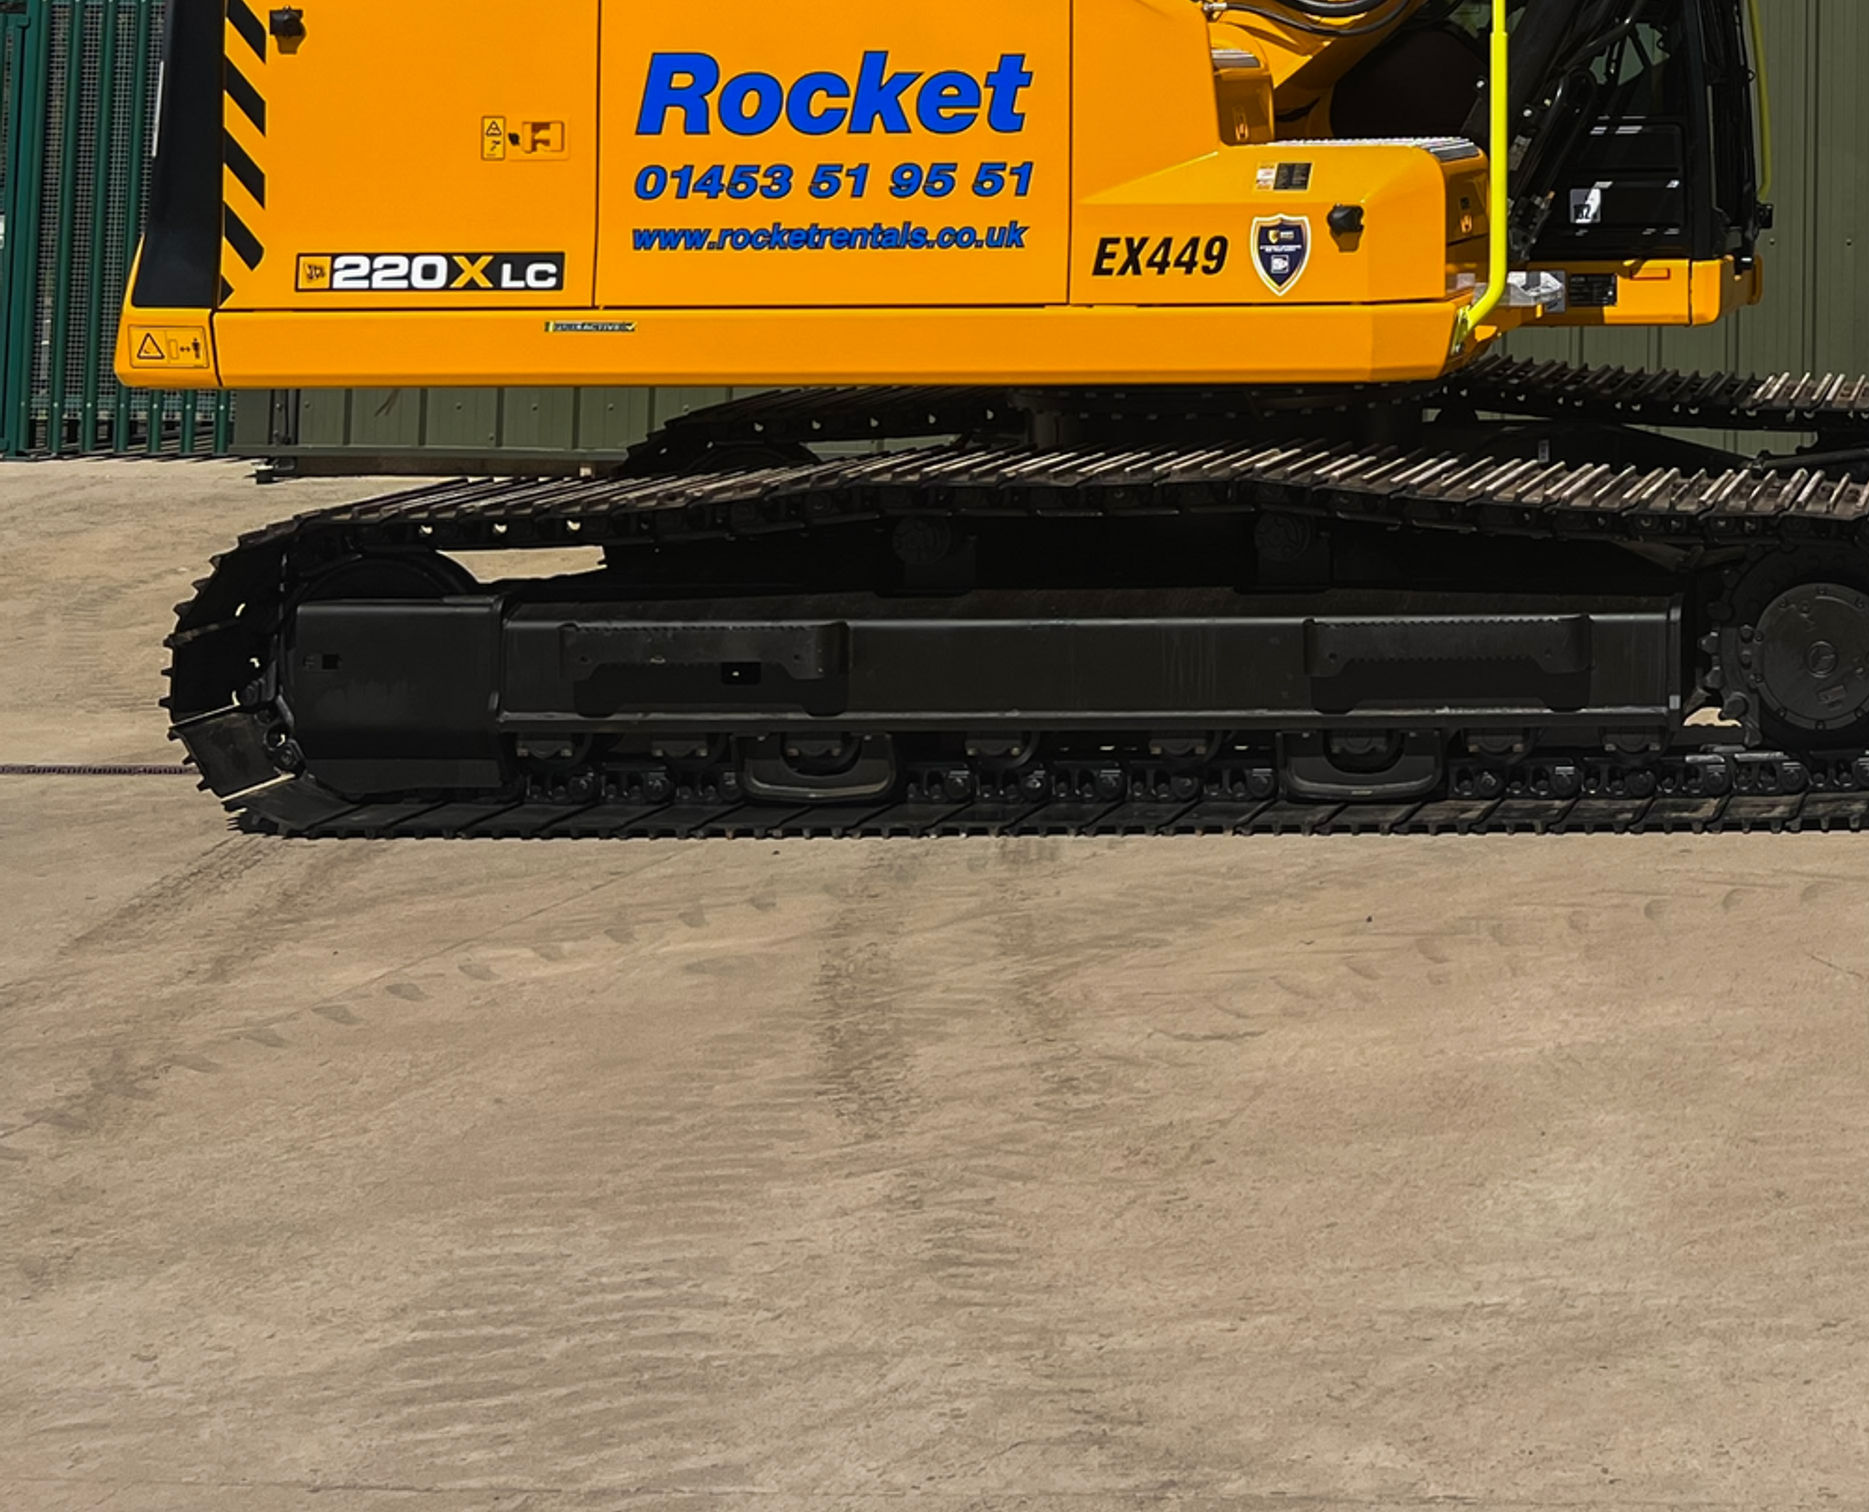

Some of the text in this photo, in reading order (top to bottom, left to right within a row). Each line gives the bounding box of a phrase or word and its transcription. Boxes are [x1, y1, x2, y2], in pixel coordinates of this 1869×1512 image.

[635, 50, 1033, 136] Rocket
[634, 161, 1033, 199] 01453 51 95 51
[632, 221, 1029, 251] www.rocketrentals.co.uk
[1092, 234, 1228, 277] EX449
[501, 262, 557, 289] LC
